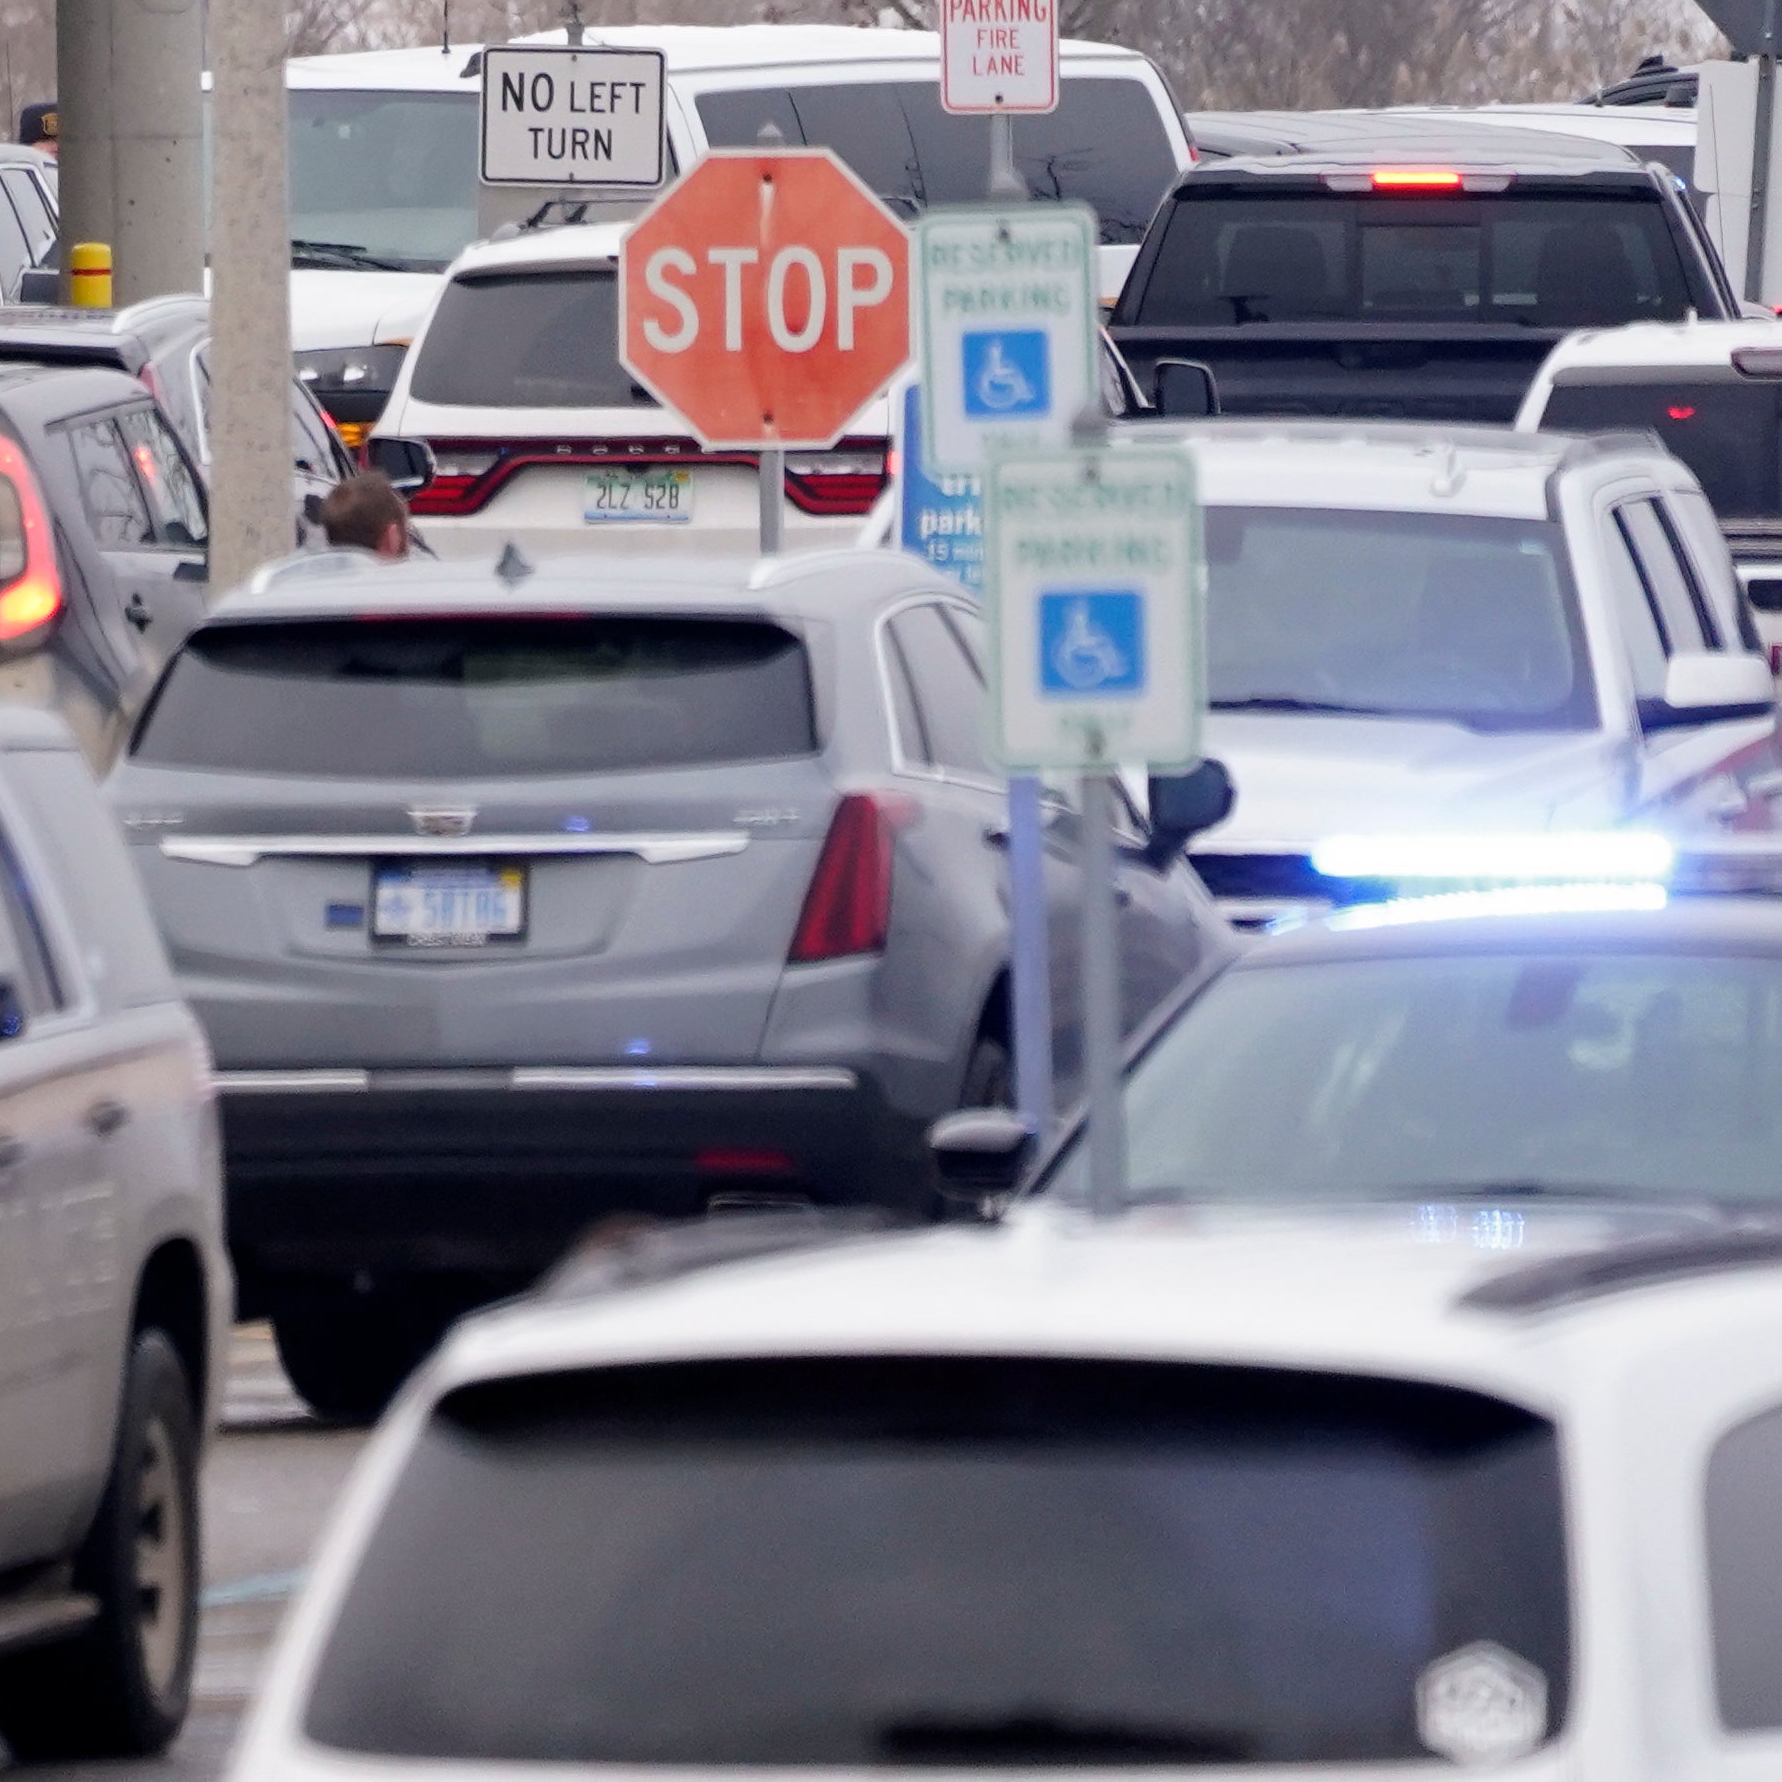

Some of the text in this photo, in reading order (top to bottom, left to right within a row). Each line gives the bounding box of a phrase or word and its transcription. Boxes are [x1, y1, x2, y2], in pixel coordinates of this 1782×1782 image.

[977, 28, 1021, 50] FIRE
[973, 55, 1026, 77] LANE
[501, 71, 646, 114] NO LEFT
[527, 127, 613, 161] TURN
[642, 245, 894, 354] STOP
[556, 443, 713, 456] DODG
